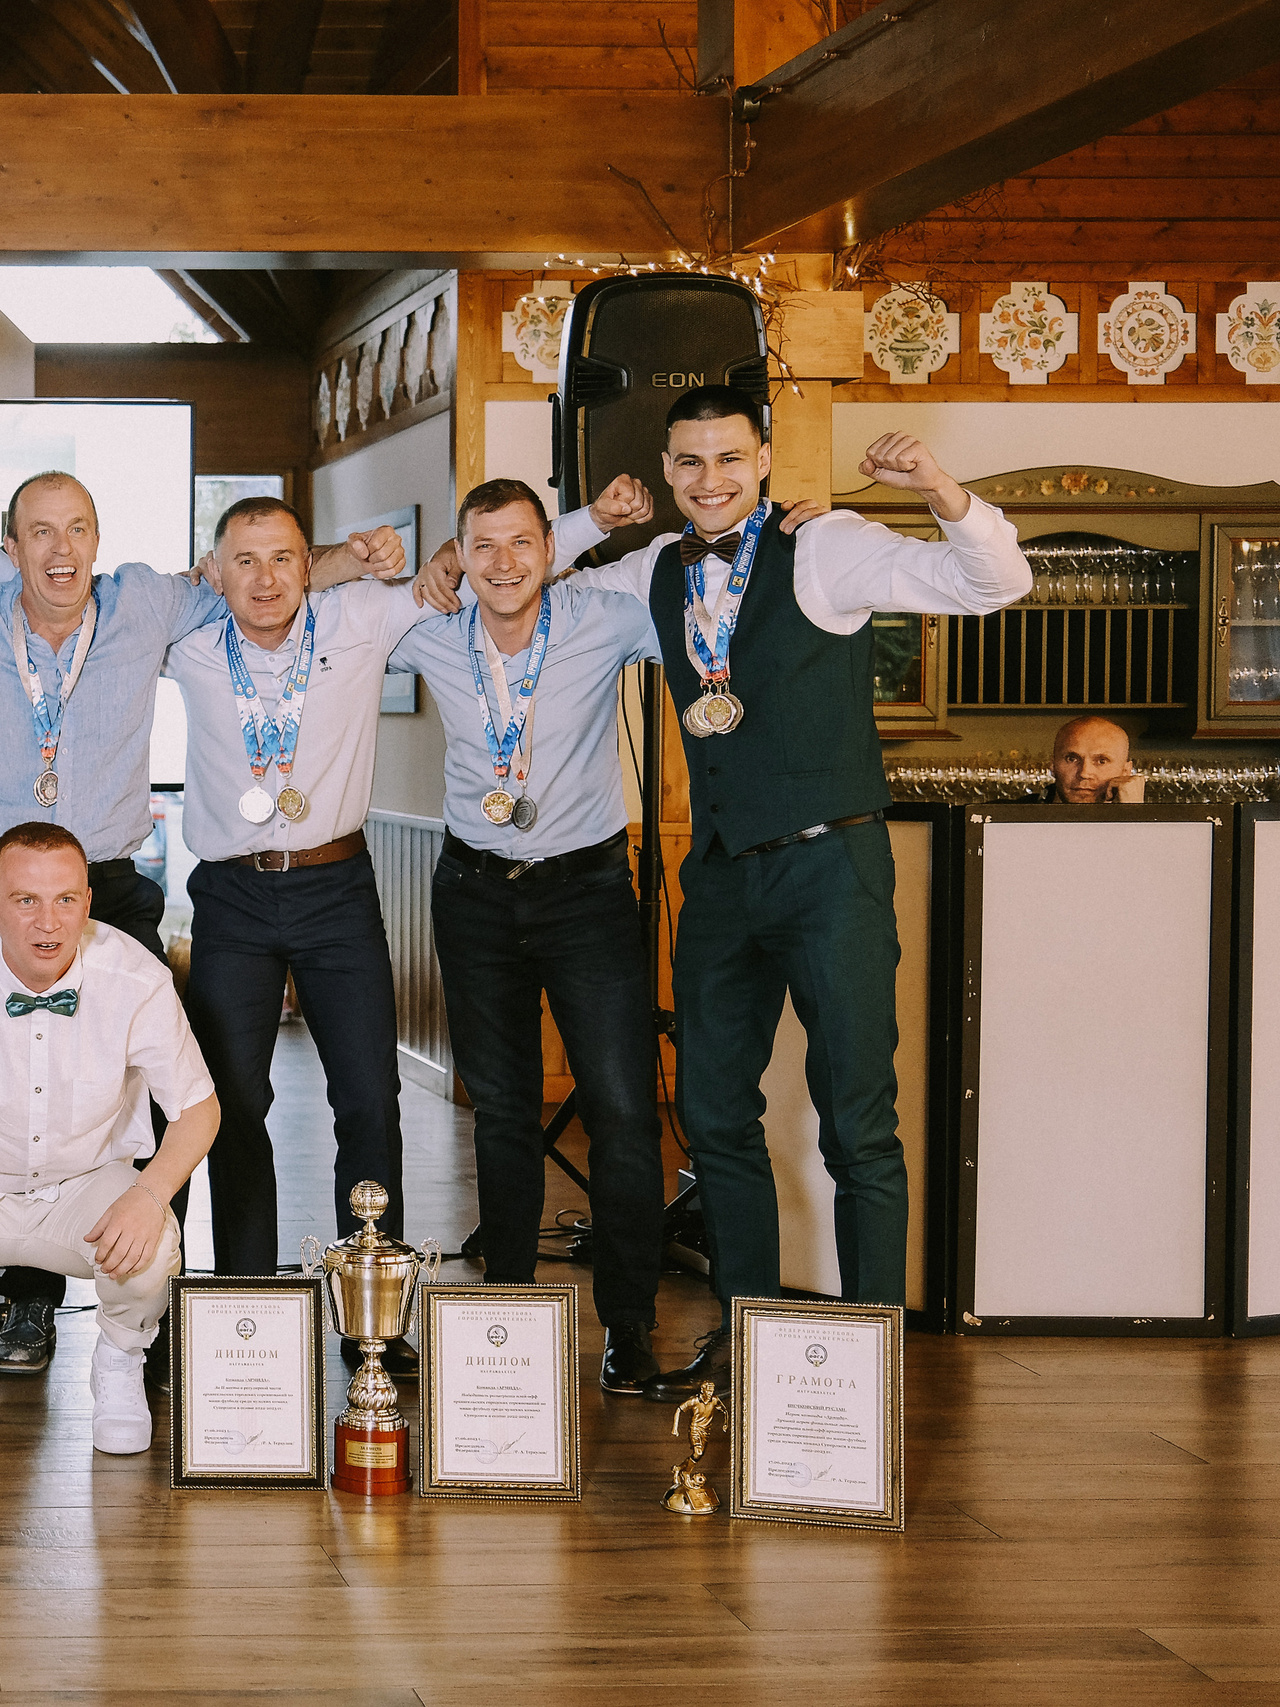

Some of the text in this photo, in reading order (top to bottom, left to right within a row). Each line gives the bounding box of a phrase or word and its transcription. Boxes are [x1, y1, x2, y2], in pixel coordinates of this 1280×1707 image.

[652, 373, 704, 387] EON
[214, 1349, 278, 1359] ДИПЛОМ
[465, 1356, 530, 1366] ДИПЛОМ
[776, 1374, 857, 1389] ГРАМОТА
